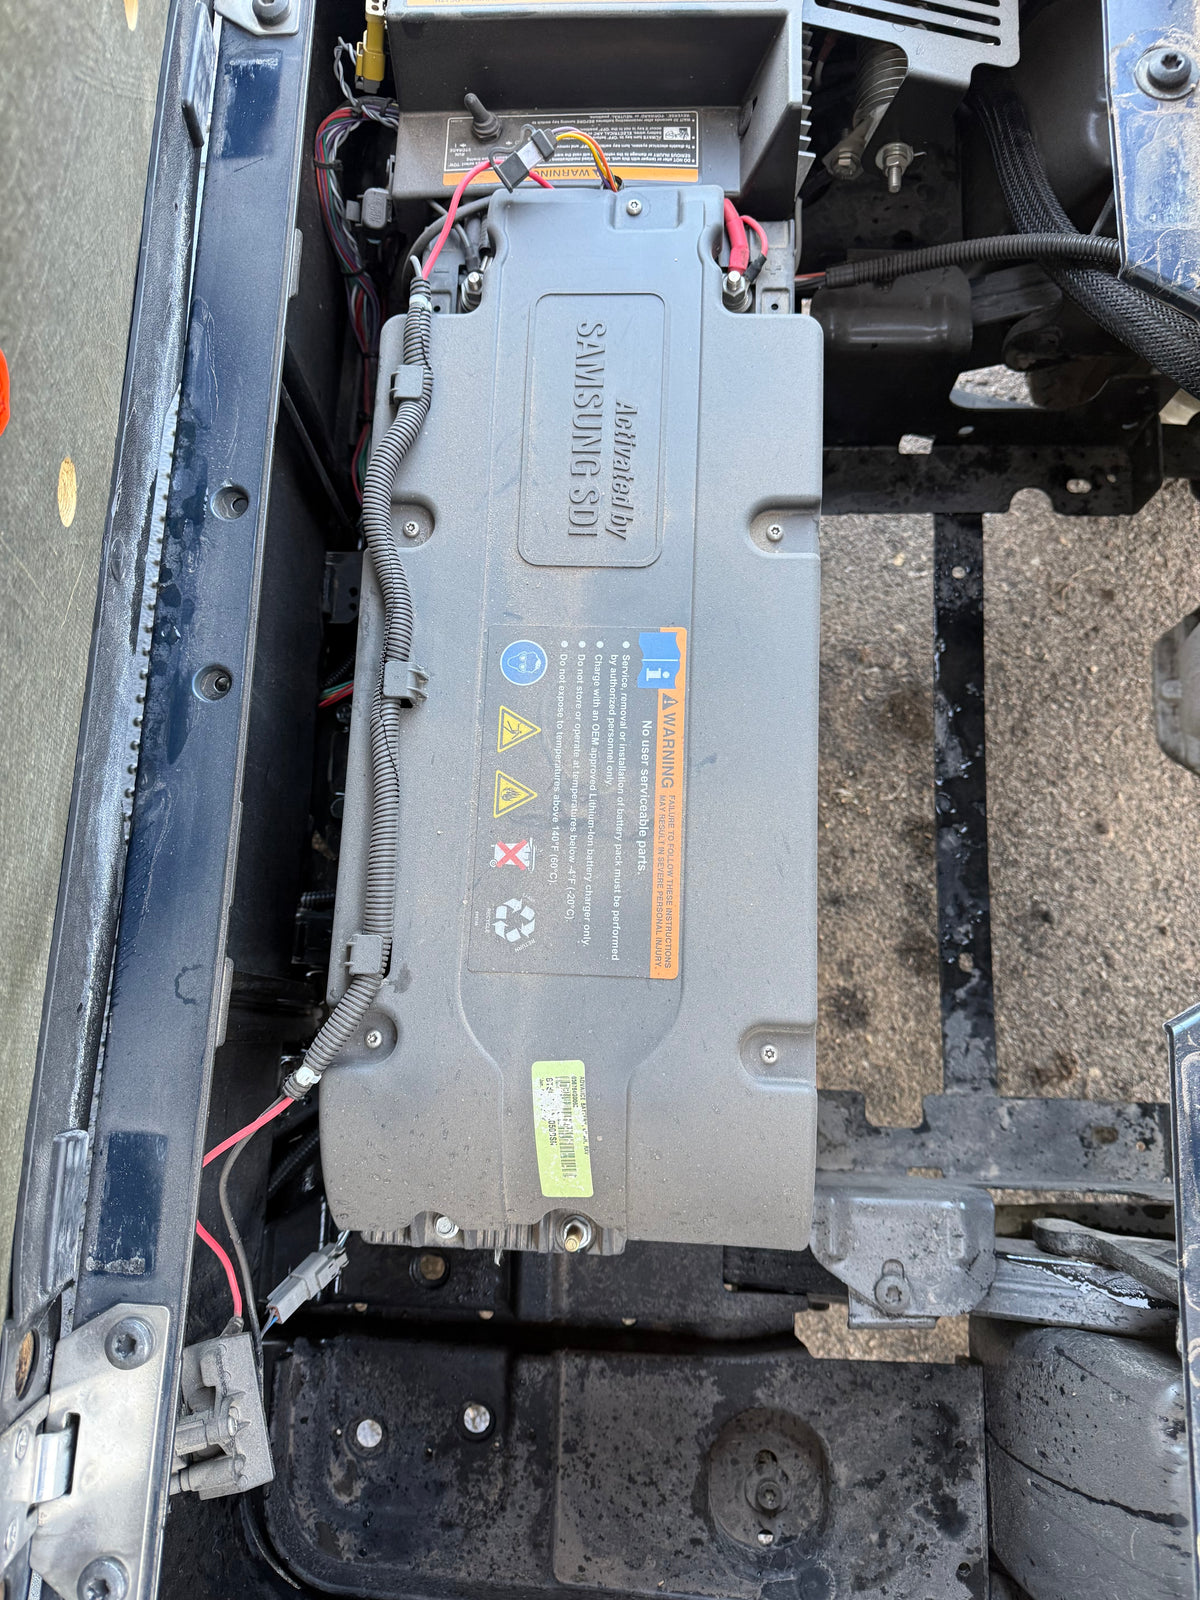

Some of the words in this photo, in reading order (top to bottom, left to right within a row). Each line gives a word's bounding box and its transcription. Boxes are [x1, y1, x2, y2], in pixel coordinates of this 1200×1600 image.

[570, 321, 607, 476] SAMSUNG
[612, 400, 638, 509] Activated
[568, 488, 602, 537] SDI
[605, 513, 633, 540] by
[558, 654, 567, 665] Do
[576, 654, 585, 666] Do
[591, 654, 602, 686] Charge
[608, 654, 618, 664] by
[619, 654, 630, 690] Service,
[558, 668, 566, 683] not
[555, 685, 564, 717] expose
[575, 686, 583, 708] store
[592, 688, 601, 708] with
[608, 667, 618, 715] authorized
[556, 720, 563, 729] to
[574, 711, 580, 720] or
[591, 710, 597, 720] an
[619, 692, 628, 728] removal
[571, 723, 581, 757] operate
[590, 723, 599, 744] OEM
[604, 717, 615, 763] personnel
[618, 731, 625, 740] or
[641, 720, 652, 736] No
[551, 731, 563, 792] temperatures
[572, 760, 580, 768] at
[640, 740, 649, 765] user
[661, 712, 675, 788] WARNING
[587, 747, 598, 790] approved
[603, 765, 614, 787] only.
[616, 743, 627, 794] installation
[551, 794, 561, 823] above
[568, 770, 580, 832] temperatures
[616, 796, 625, 806] of
[638, 768, 650, 836] serviceable
[586, 793, 597, 846] Lithium-Ion
[614, 808, 624, 840] battery
[657, 814, 665, 844] RESULT
[550, 825, 559, 851] 140°F
[568, 835, 577, 862] below
[657, 846, 664, 854] IN
[667, 831, 674, 841] TO
[583, 849, 594, 881] battery
[613, 843, 623, 865] pack
[635, 840, 647, 875] parts.
[546, 854, 558, 885] (60°C).
[567, 865, 576, 883] -4°F
[613, 869, 621, 893] must
[656, 857, 664, 888] SEVERE
[582, 884, 593, 920] charger
[612, 895, 621, 907] be
[655, 891, 663, 935] PERSONAL
[580, 924, 591, 947] only.
[609, 910, 621, 960] performed
[663, 907, 671, 968] INSTRUCTIONS
